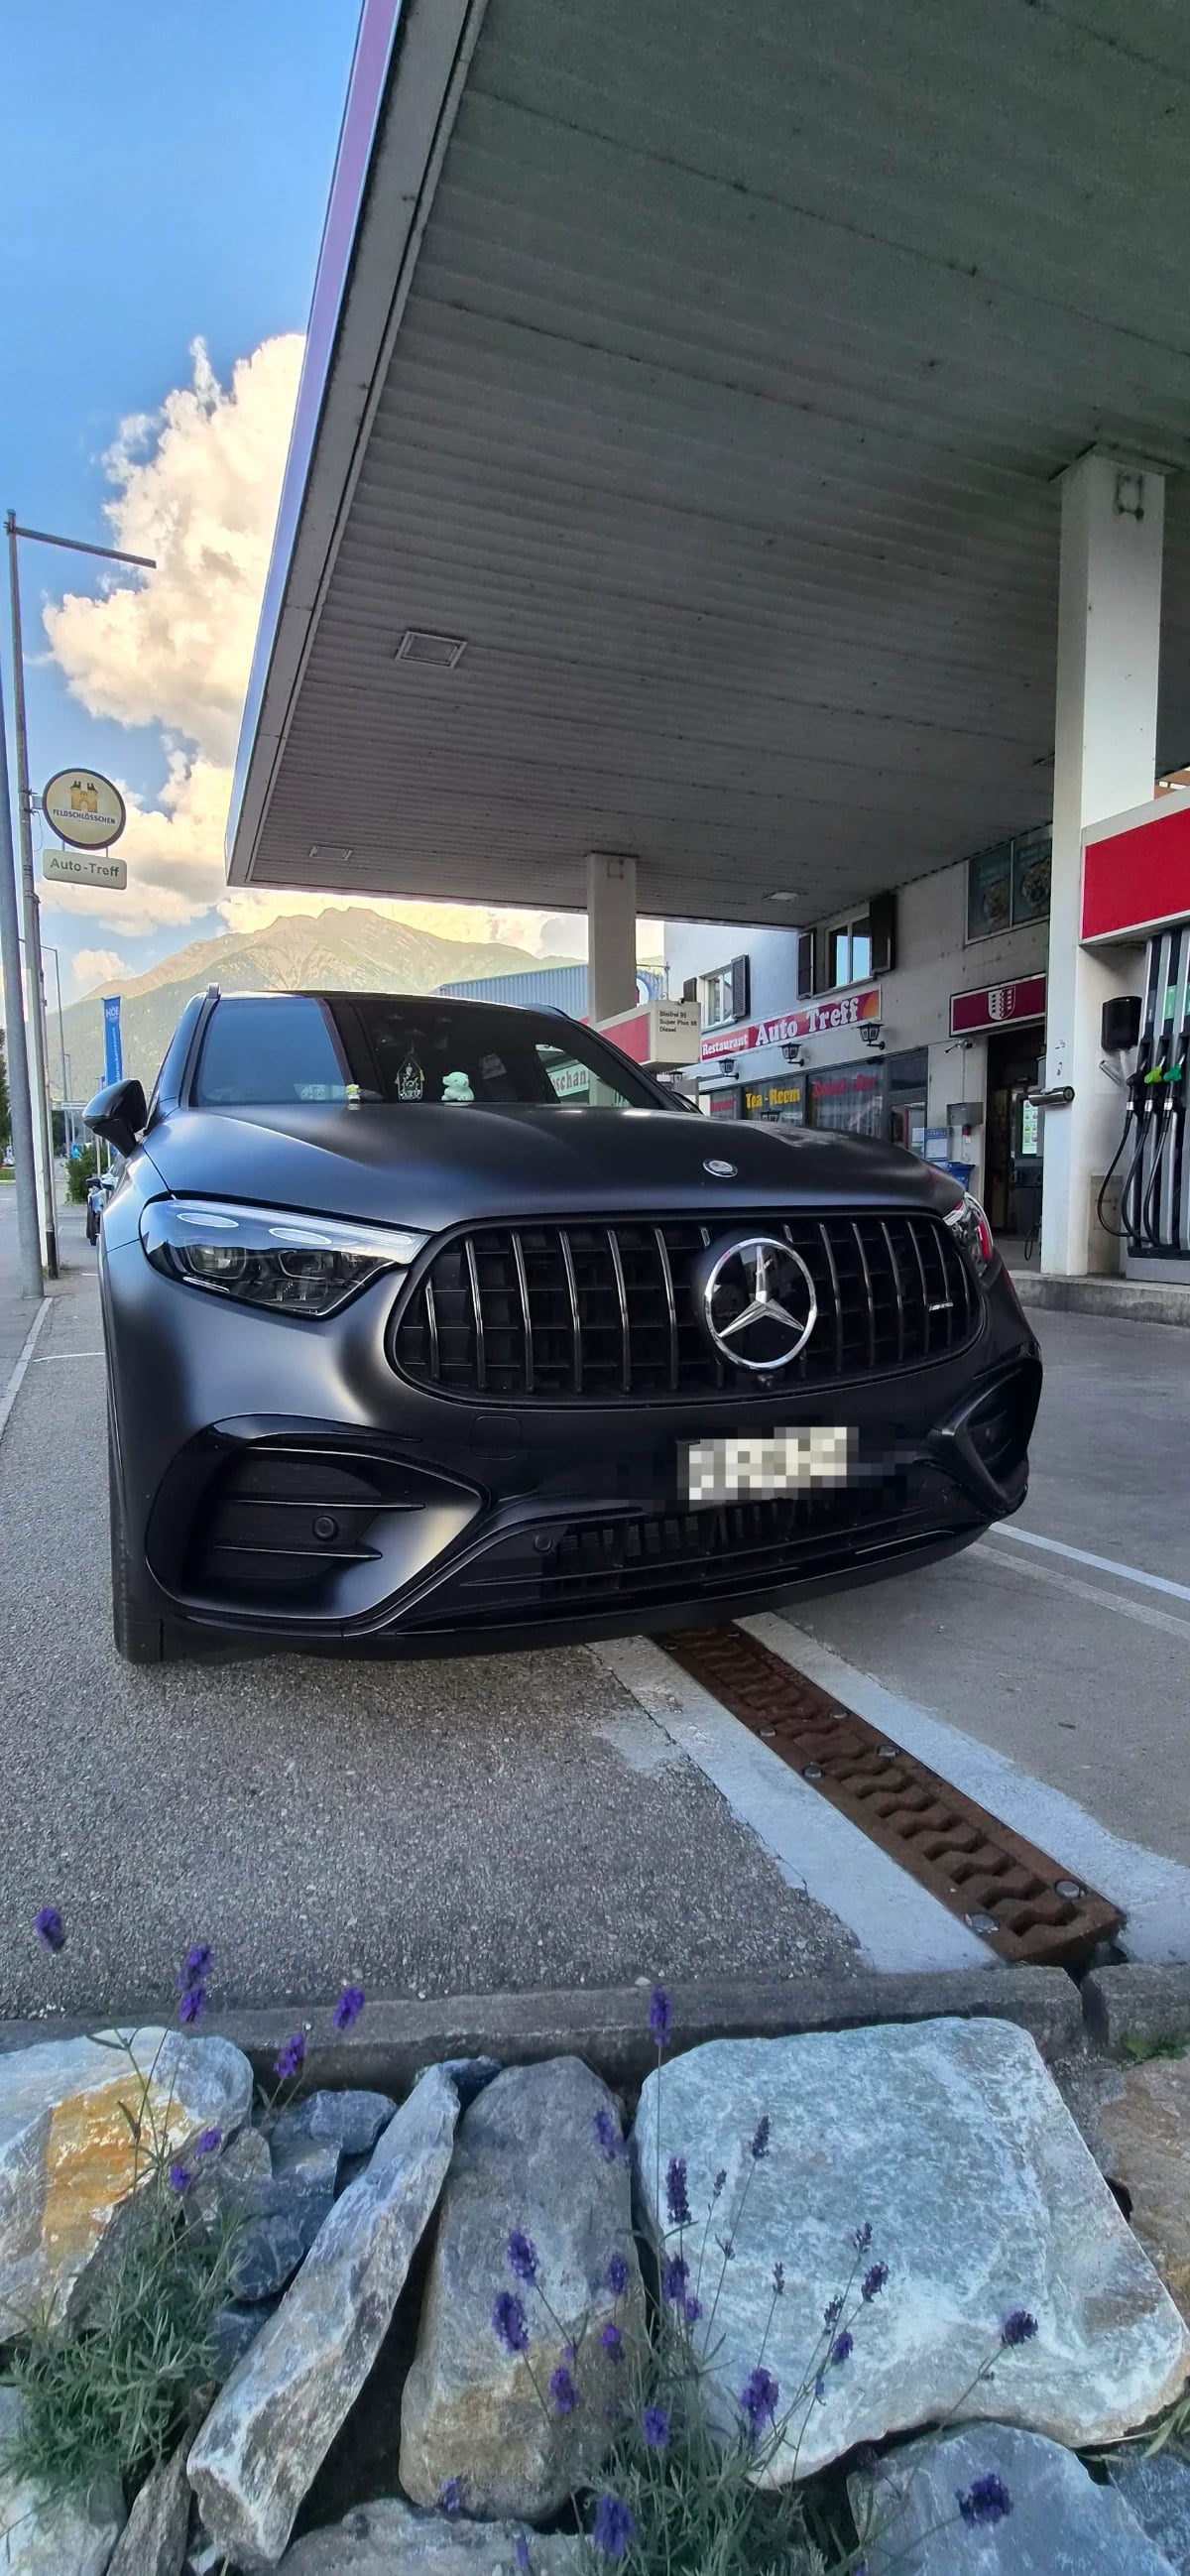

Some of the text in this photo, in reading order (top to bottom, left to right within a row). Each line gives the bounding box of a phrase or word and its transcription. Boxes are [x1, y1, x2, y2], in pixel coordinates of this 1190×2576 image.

[53, 808, 116, 824] FELDSCHLÖSSCHEN
[50, 858, 119, 877] Auto-Treff
[702, 998, 859, 1055] Restaurant Auto Treff
